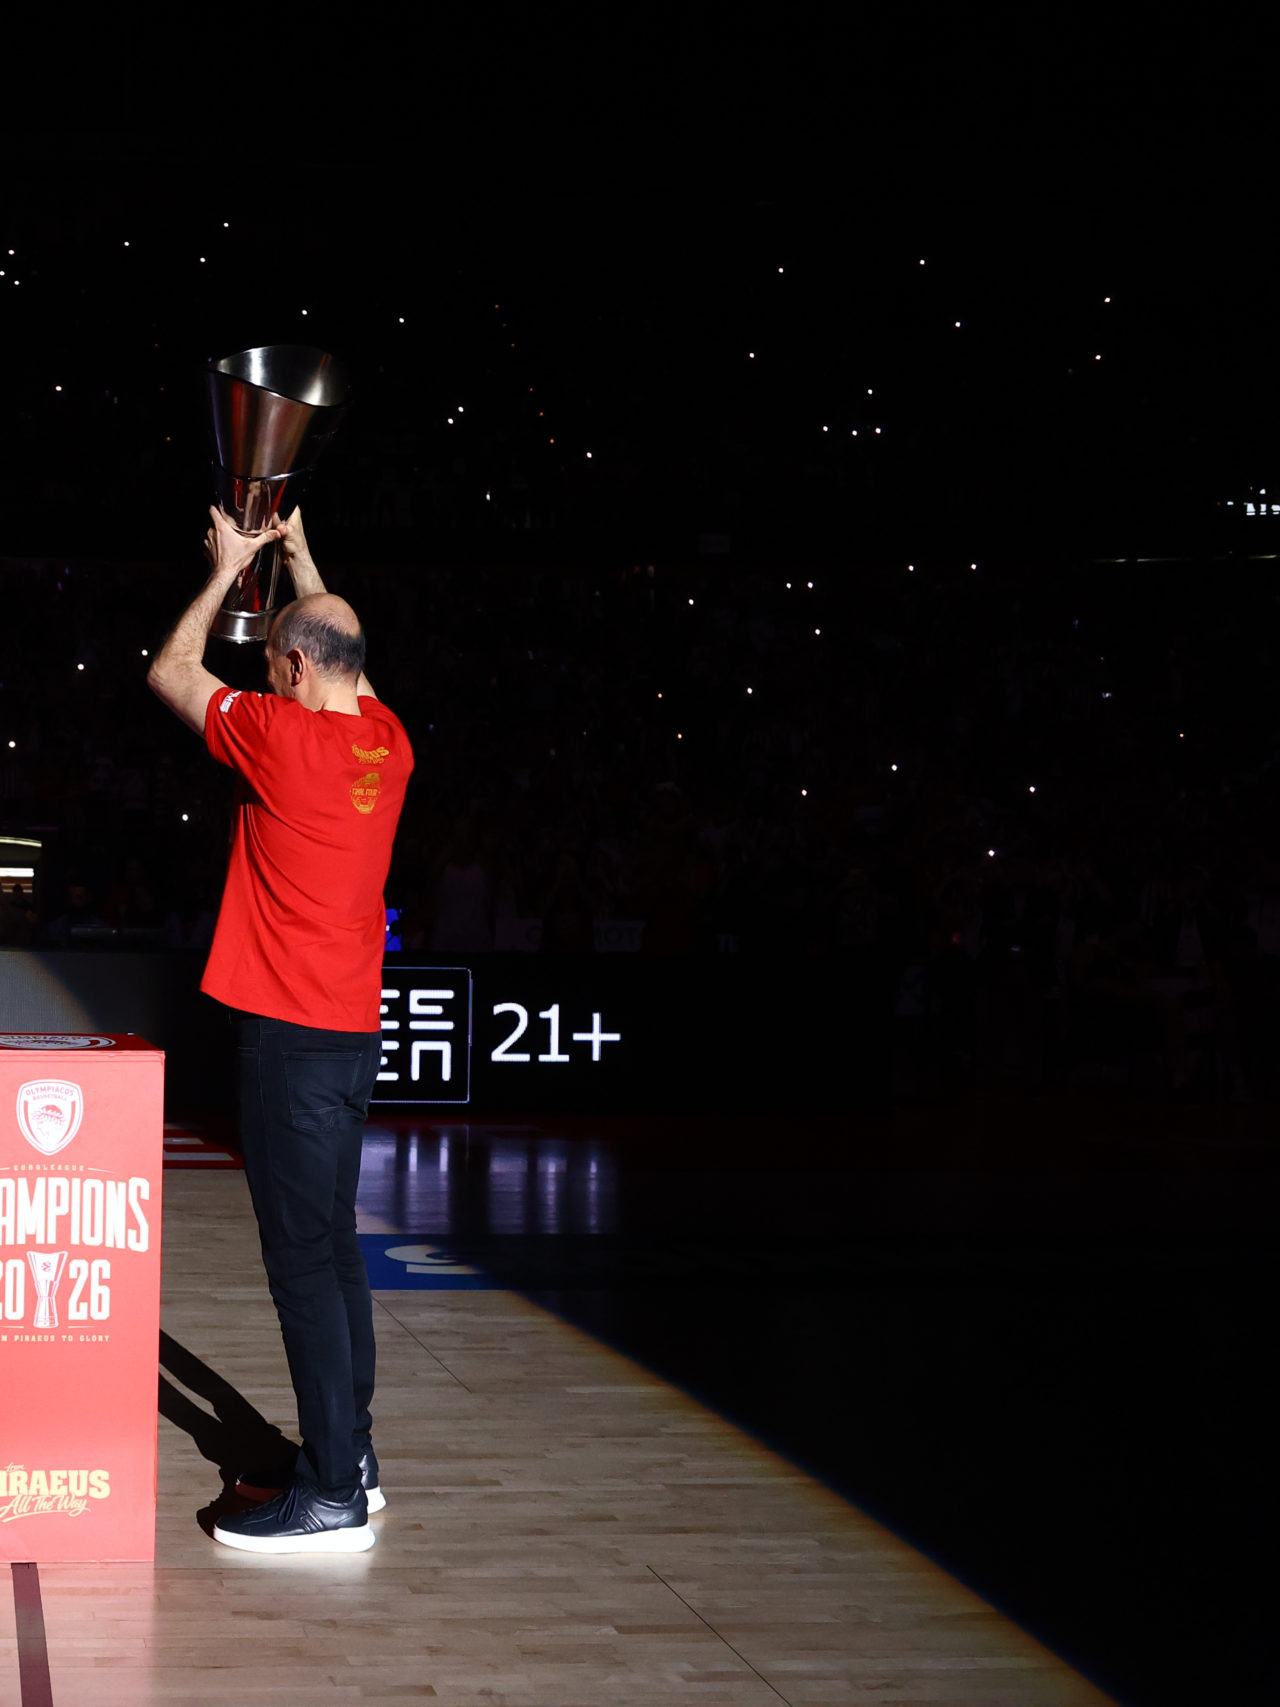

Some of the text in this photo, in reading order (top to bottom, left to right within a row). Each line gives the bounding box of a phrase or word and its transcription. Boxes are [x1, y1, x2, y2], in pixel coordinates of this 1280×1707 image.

[490, 1002, 622, 1063] 21+
[26, 1085, 75, 1097] OLYMPIACOS
[13, 1164, 85, 1172] EUROLEAGUE
[68, 1259, 111, 1321] 26
[14, 1334, 56, 1342] PIRAEUS
[62, 1334, 73, 1342] TO
[80, 1334, 110, 1342] GLORY
[31, 1494, 54, 1511] The
[53, 1493, 91, 1517] Way
